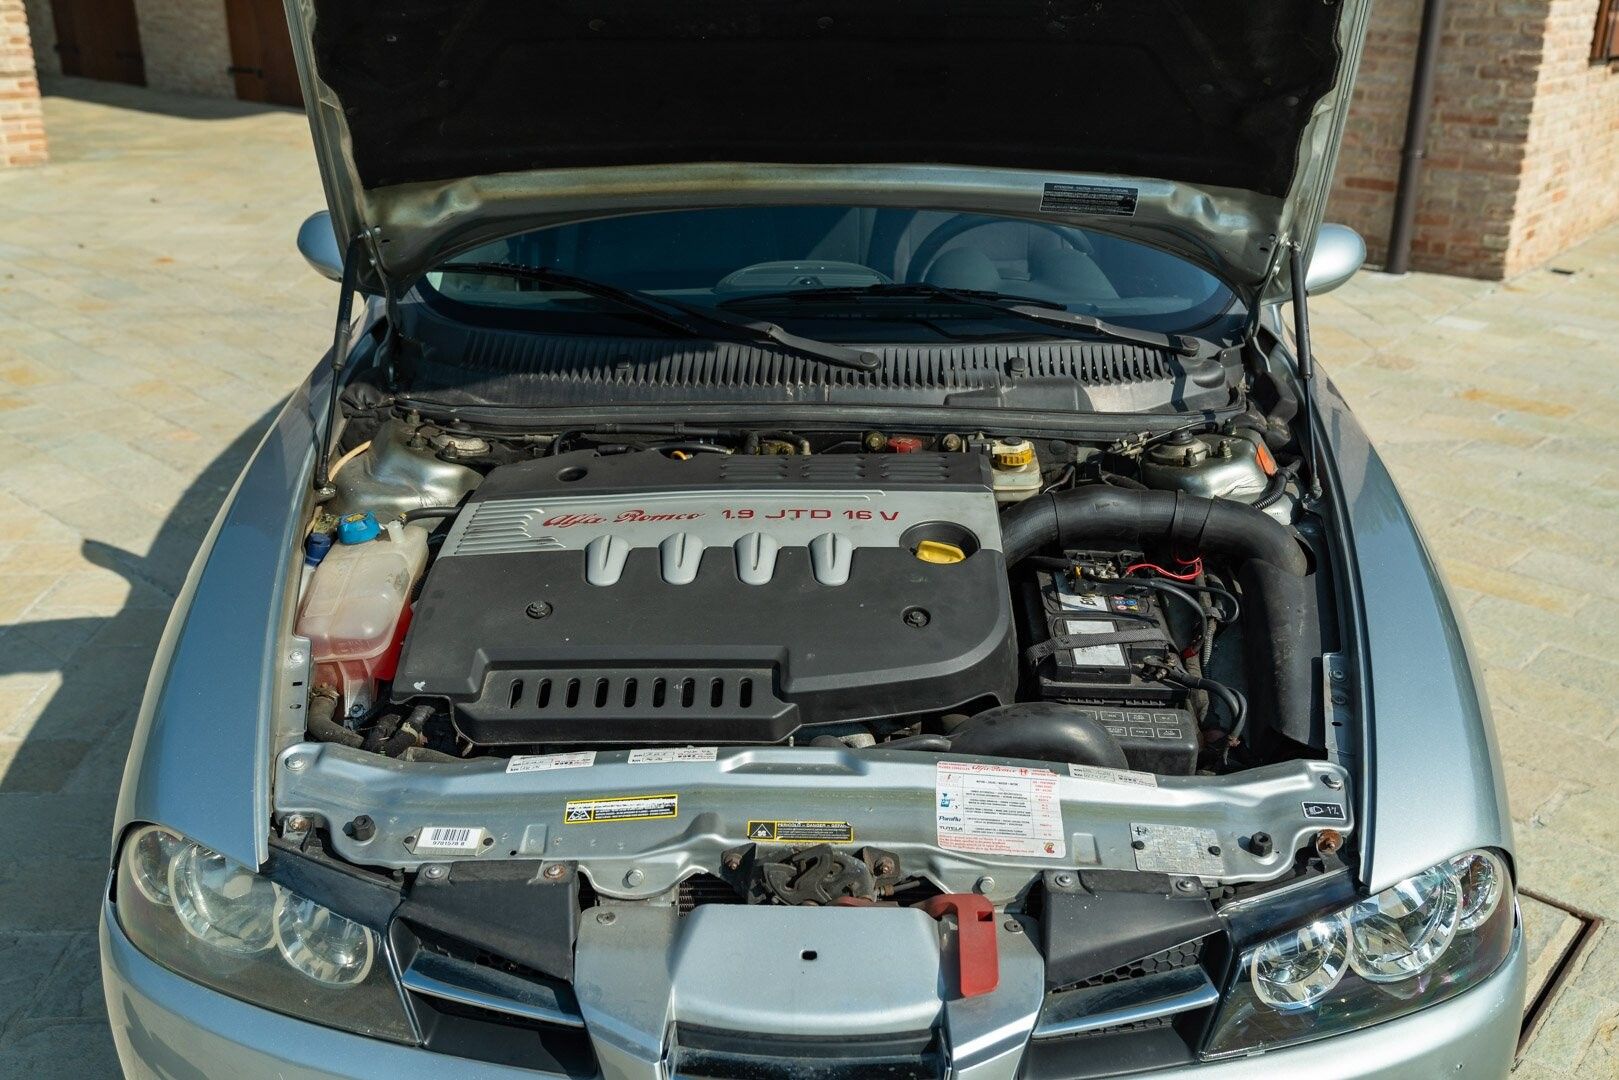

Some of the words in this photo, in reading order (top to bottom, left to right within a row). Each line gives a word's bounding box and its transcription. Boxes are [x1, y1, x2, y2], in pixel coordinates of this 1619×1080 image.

[543, 513, 607, 528] Alfa
[613, 509, 705, 523] Romeo
[722, 509, 754, 520] 1.9
[765, 509, 832, 519] JTD
[843, 510, 873, 520] 16
[880, 511, 900, 521] V
